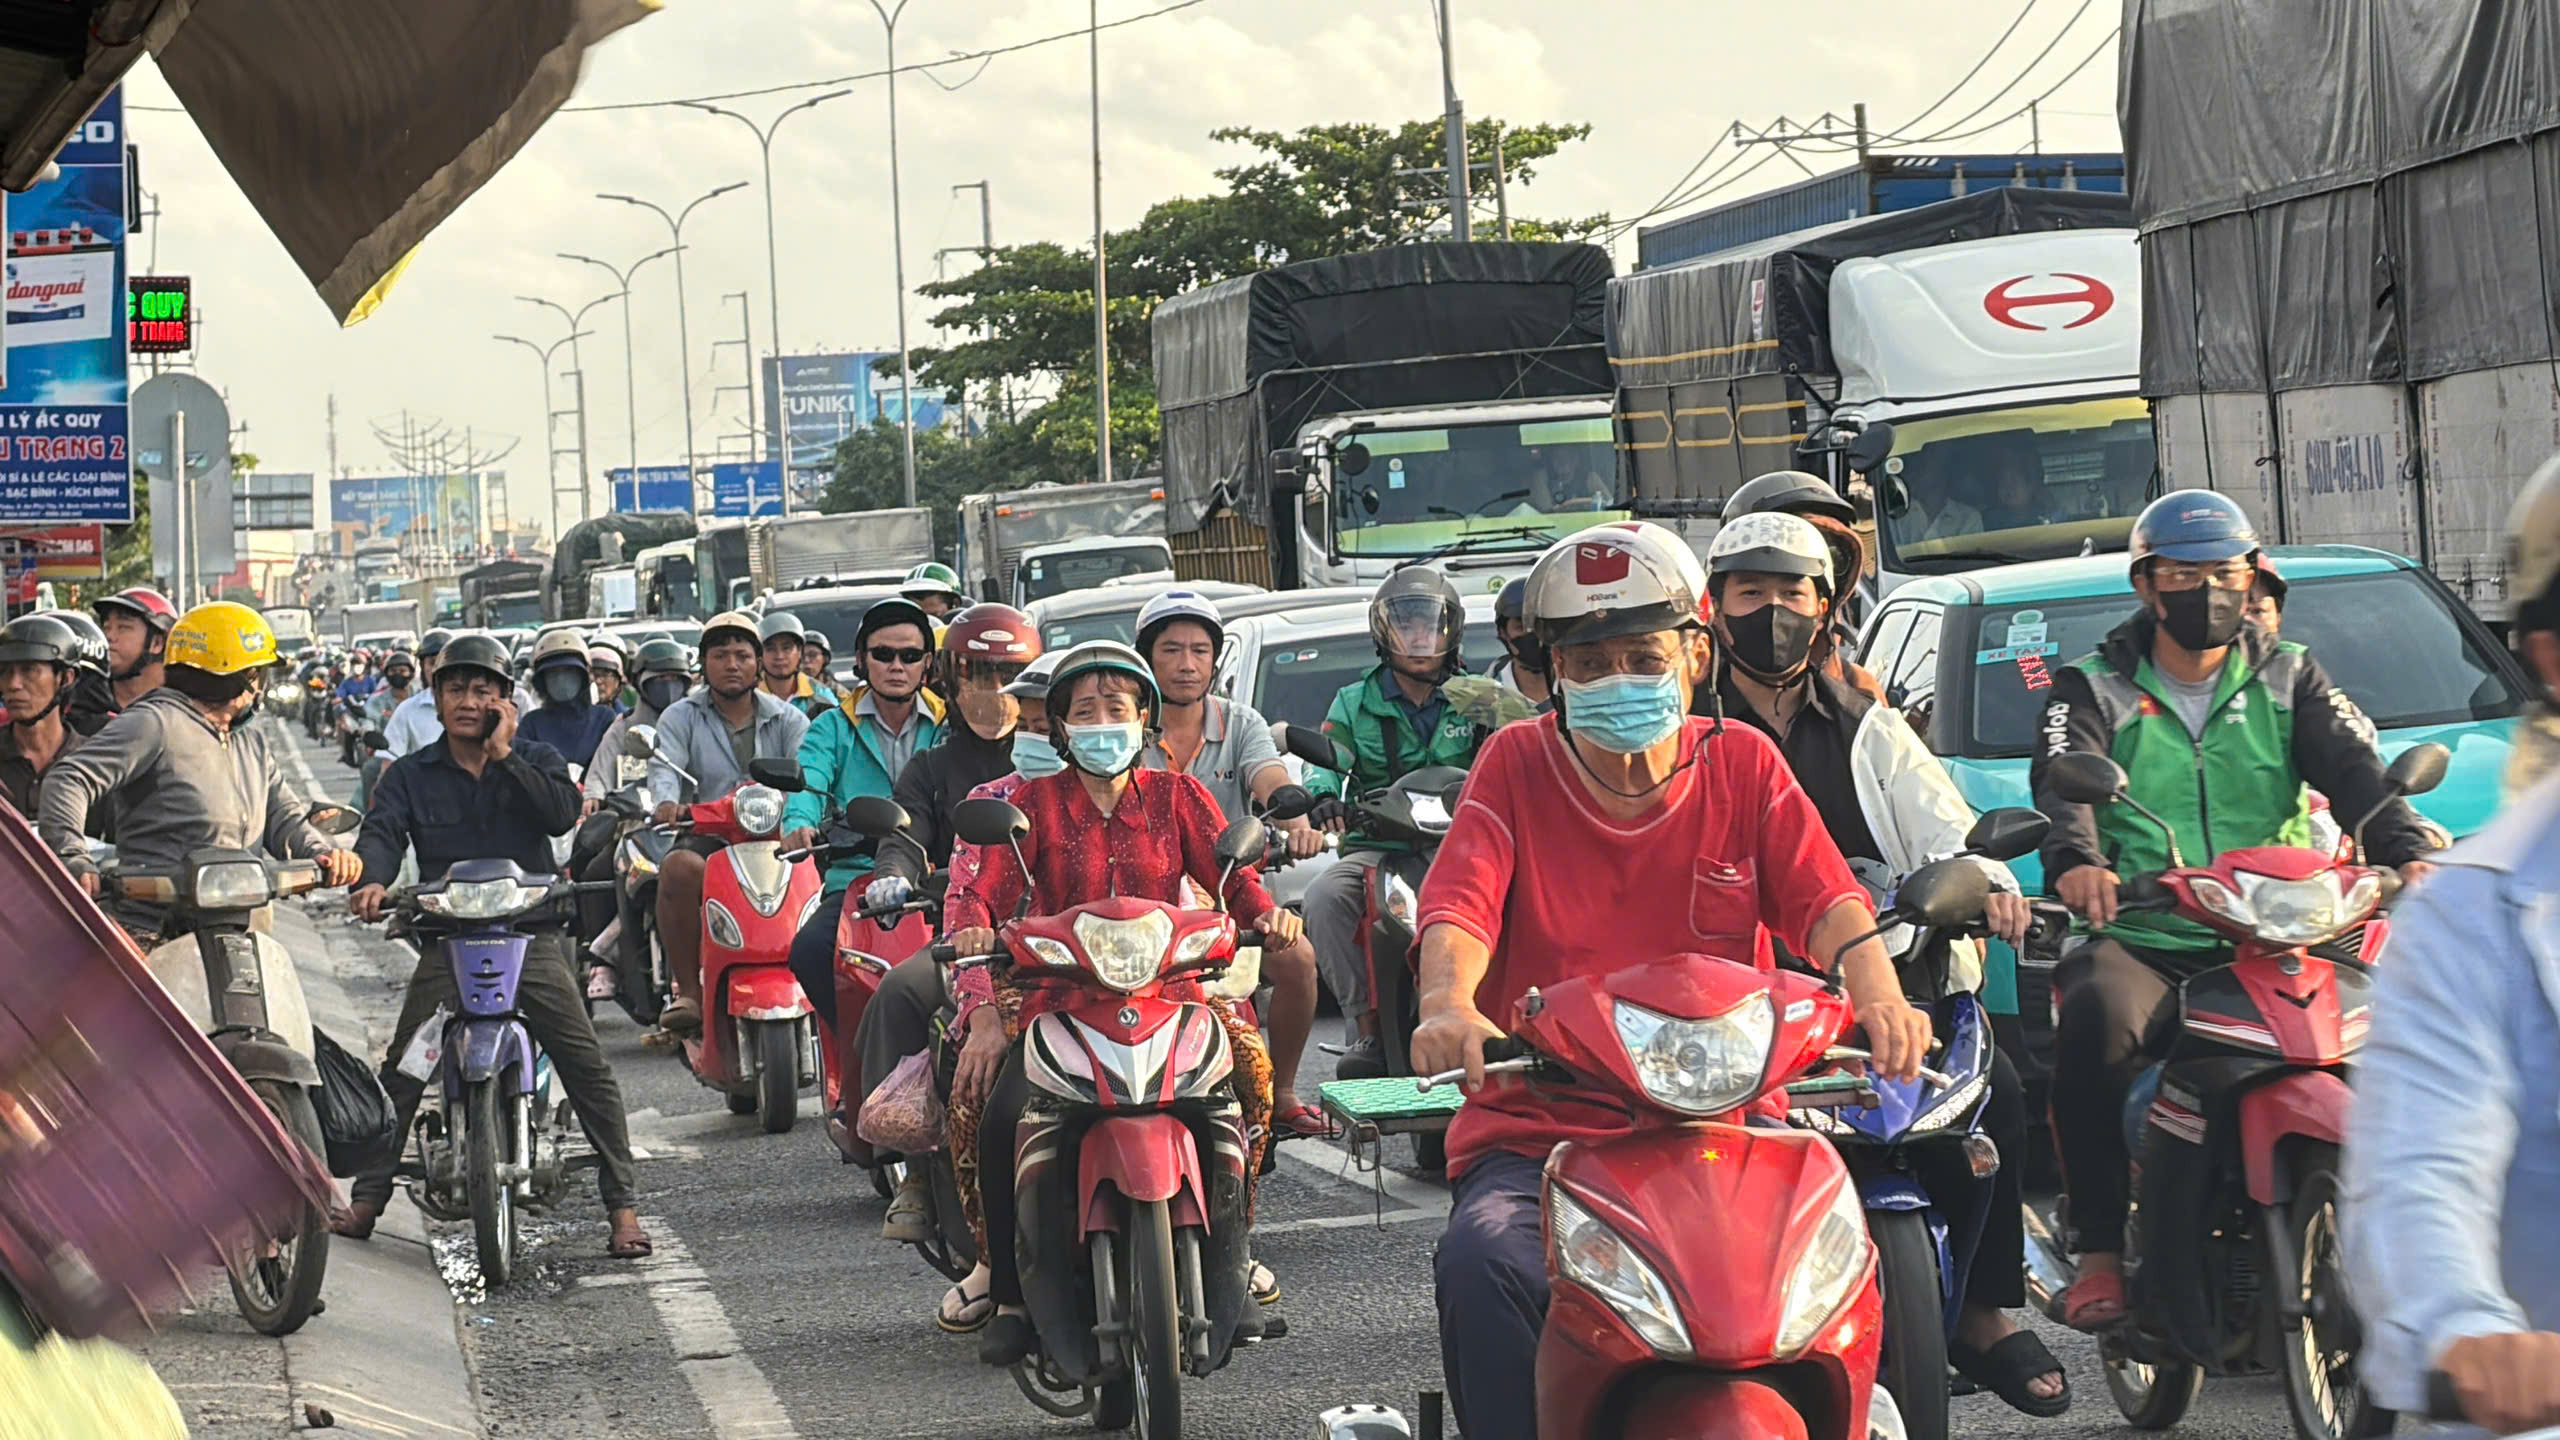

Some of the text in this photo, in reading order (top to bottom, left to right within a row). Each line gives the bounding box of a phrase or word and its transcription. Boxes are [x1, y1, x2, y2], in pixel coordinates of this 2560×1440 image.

[64, 413, 102, 429] QUY
[15, 435, 105, 463] TRANG
[109, 435, 125, 460] 2
